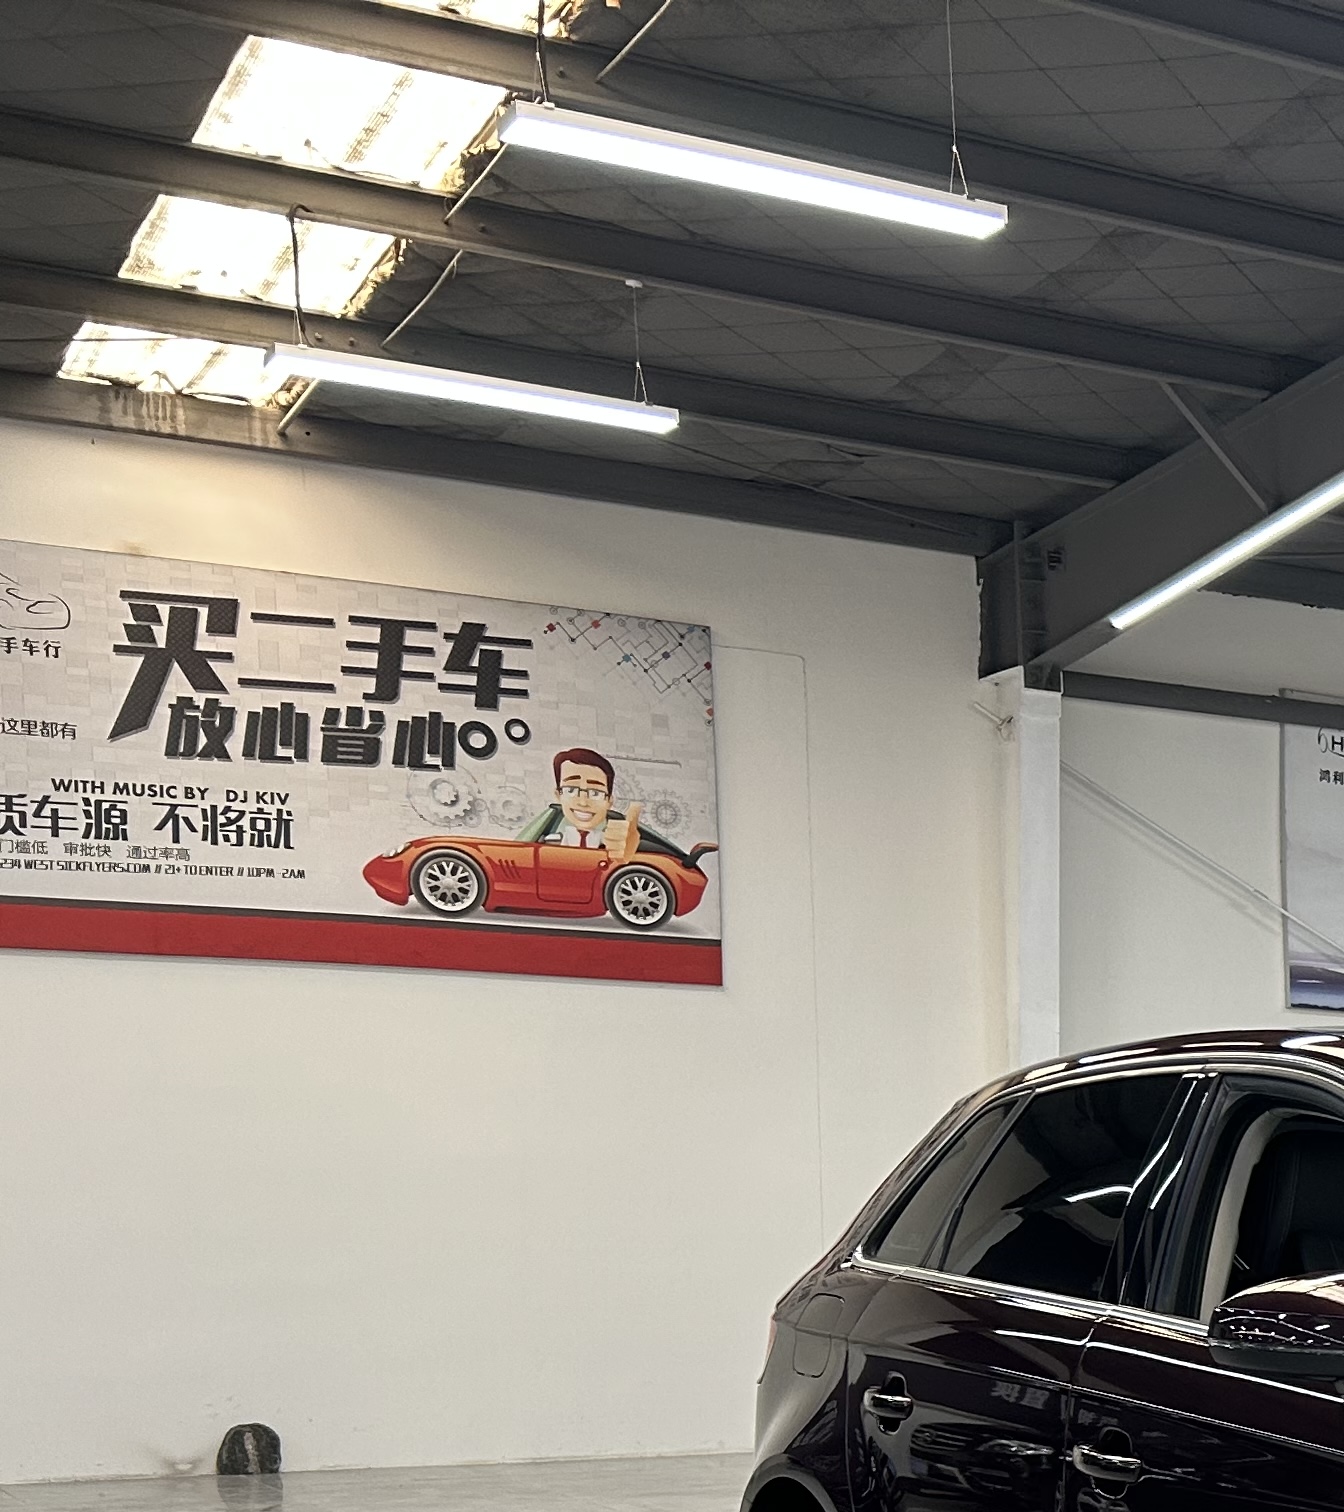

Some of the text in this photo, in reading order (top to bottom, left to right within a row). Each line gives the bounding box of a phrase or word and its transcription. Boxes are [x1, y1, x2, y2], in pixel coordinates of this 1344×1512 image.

[107, 590, 533, 742] 买二手车
[50, 777, 290, 806] WITH MUSIC BY DJ KIV
[151, 801, 295, 850] 不将就
